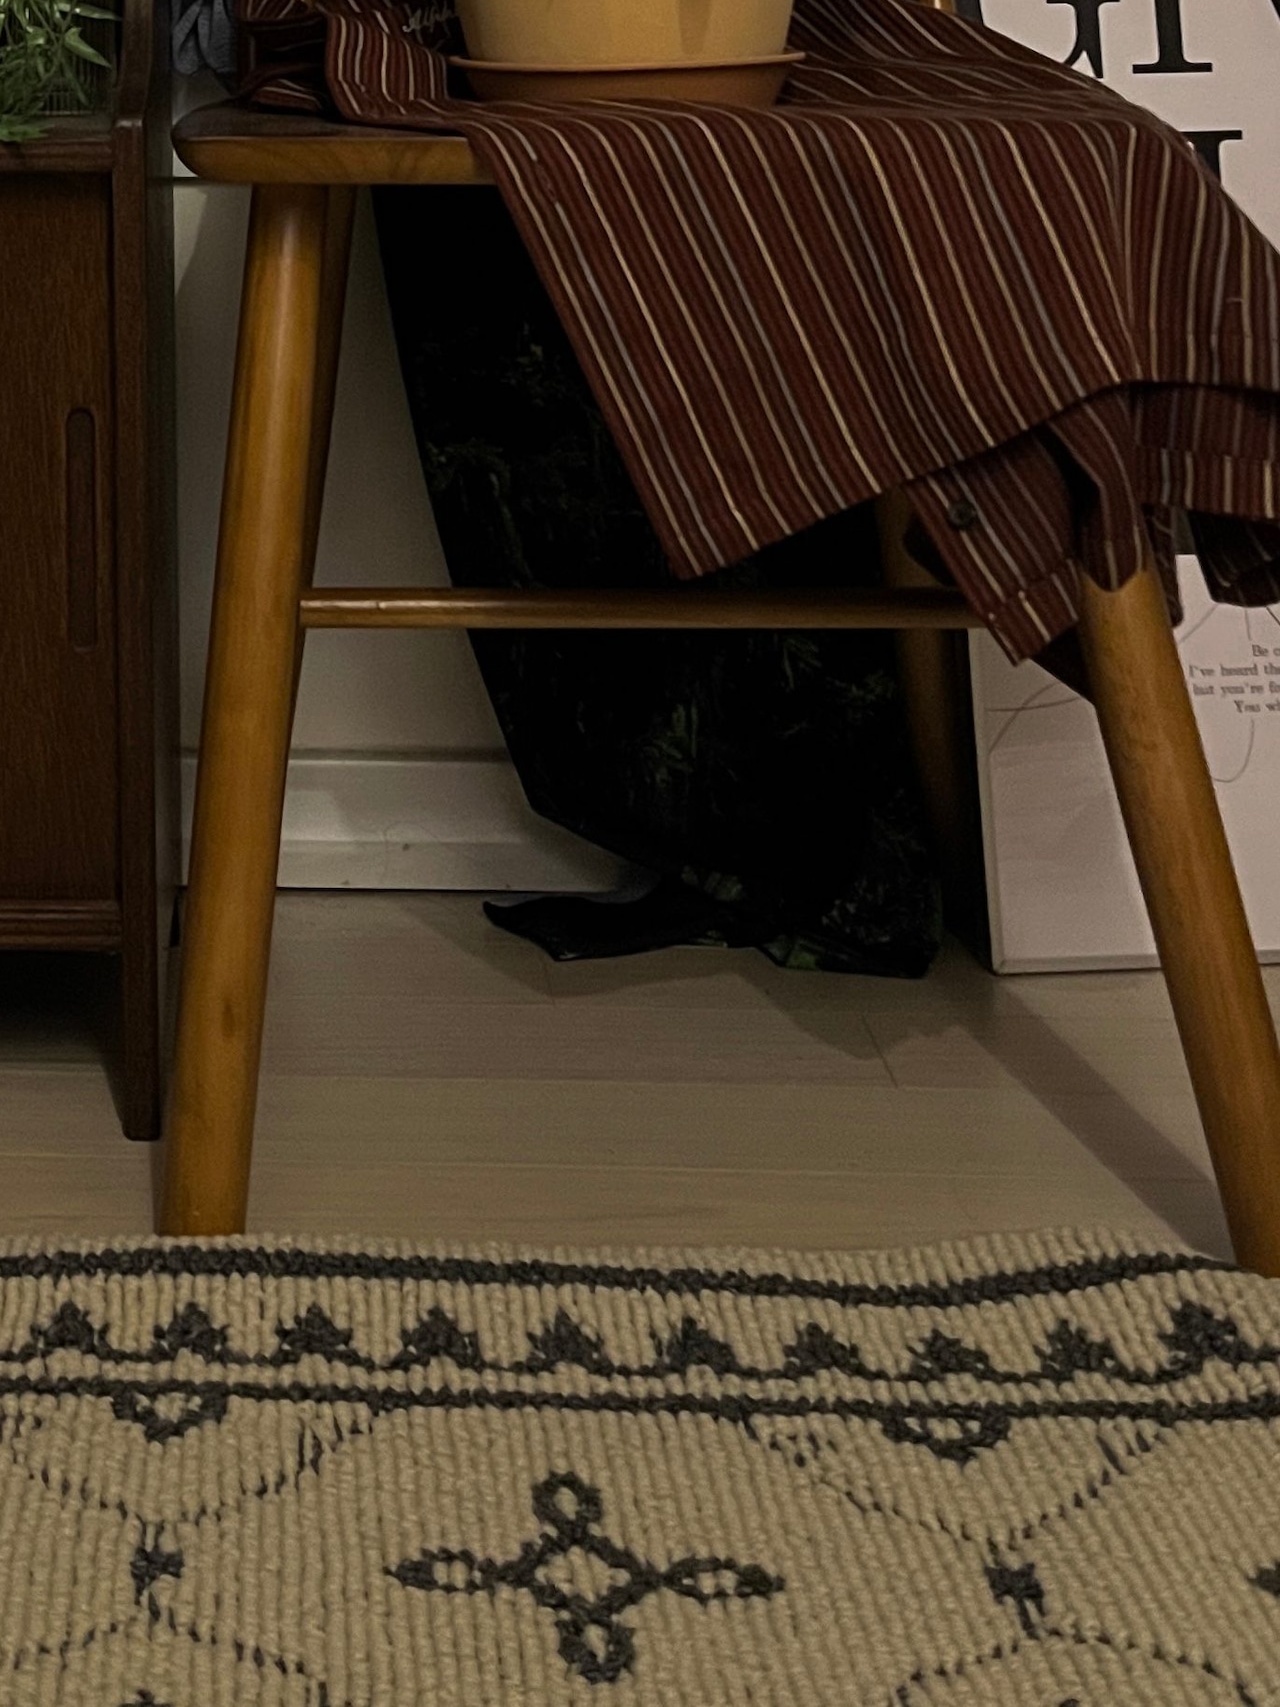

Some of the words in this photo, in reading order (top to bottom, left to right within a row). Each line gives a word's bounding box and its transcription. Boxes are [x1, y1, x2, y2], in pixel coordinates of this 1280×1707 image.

[1251, 644, 1269, 658] Be
[1189, 664, 1215, 678] I've
[1219, 663, 1258, 676] heard
[1194, 683, 1215, 696] but
[1220, 682, 1264, 699] you're
[1234, 700, 1261, 713] You
